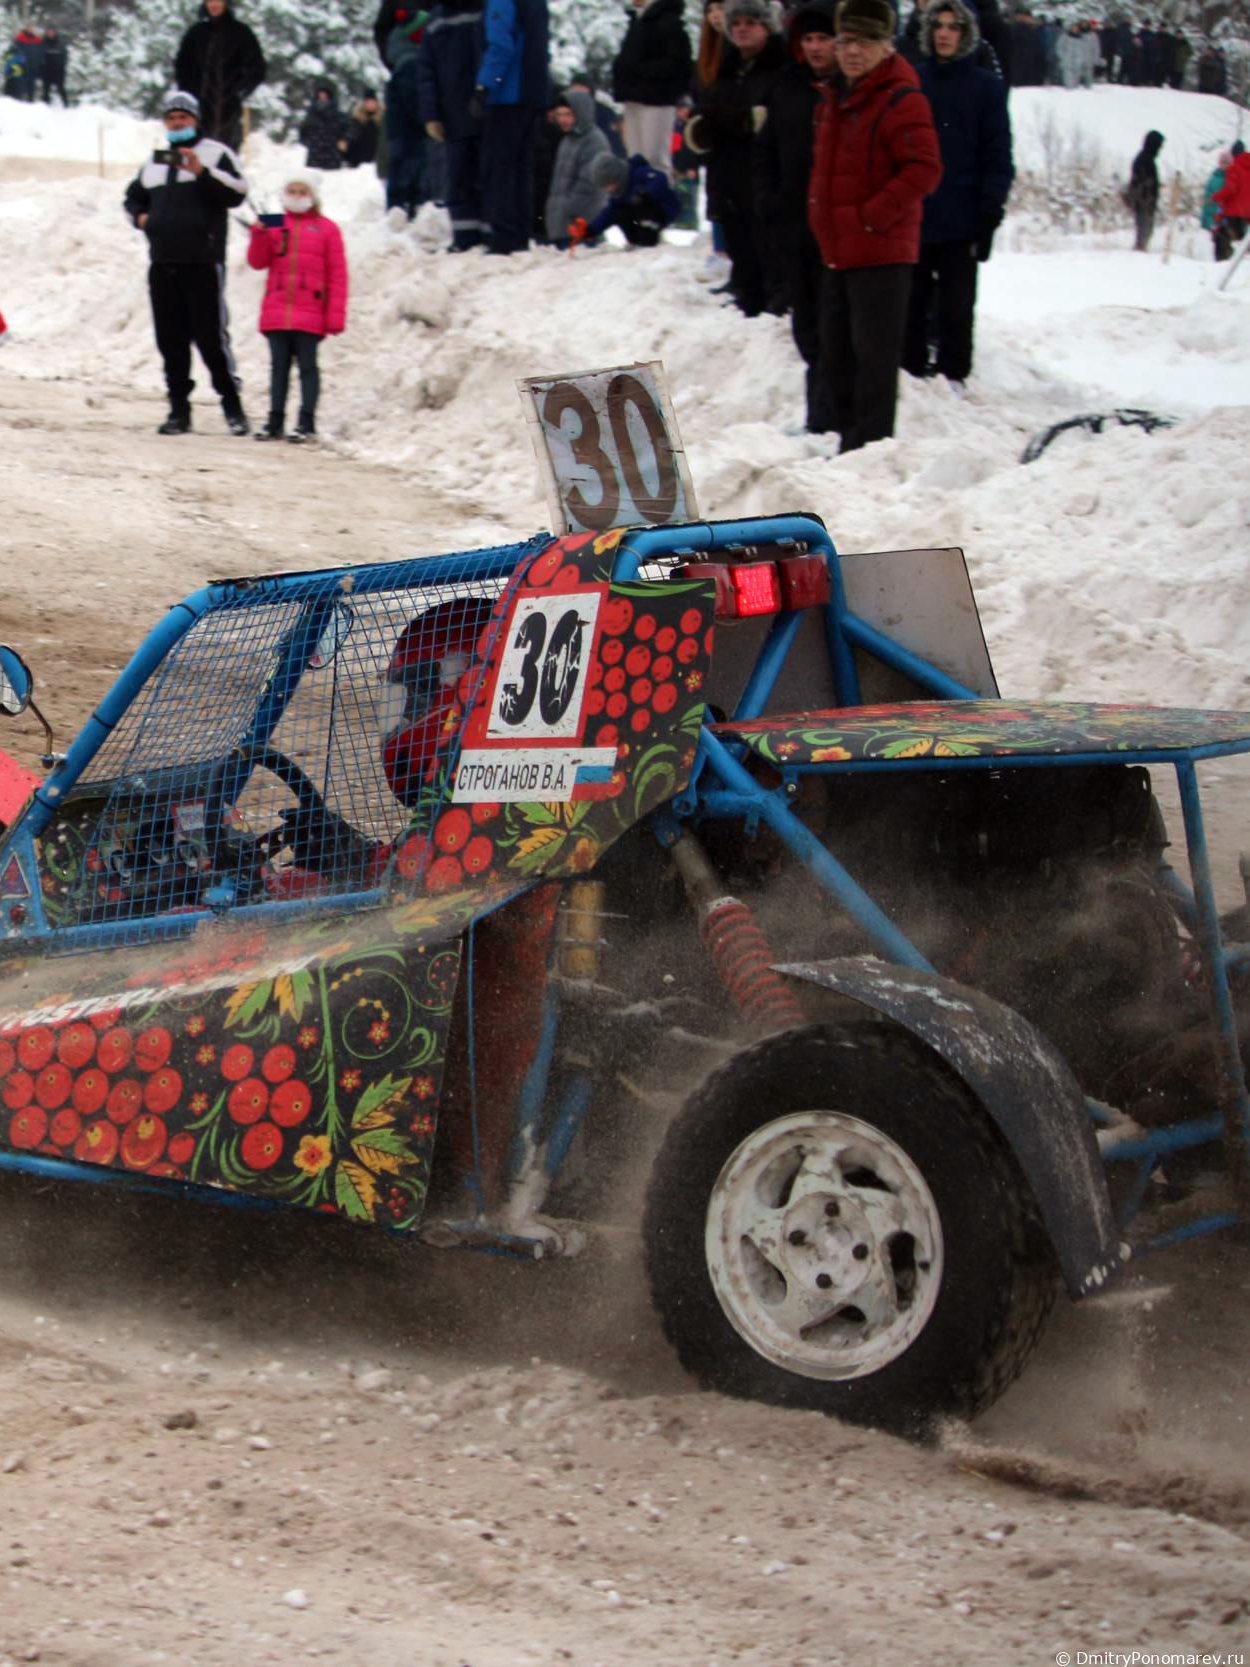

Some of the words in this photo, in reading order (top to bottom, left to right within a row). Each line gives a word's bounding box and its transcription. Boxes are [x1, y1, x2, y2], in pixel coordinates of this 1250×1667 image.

[543, 374, 677, 530] 30
[499, 609, 583, 725] 30
[458, 764, 539, 790] СТРОГАНОВ
[541, 764, 567, 790] В.А.
